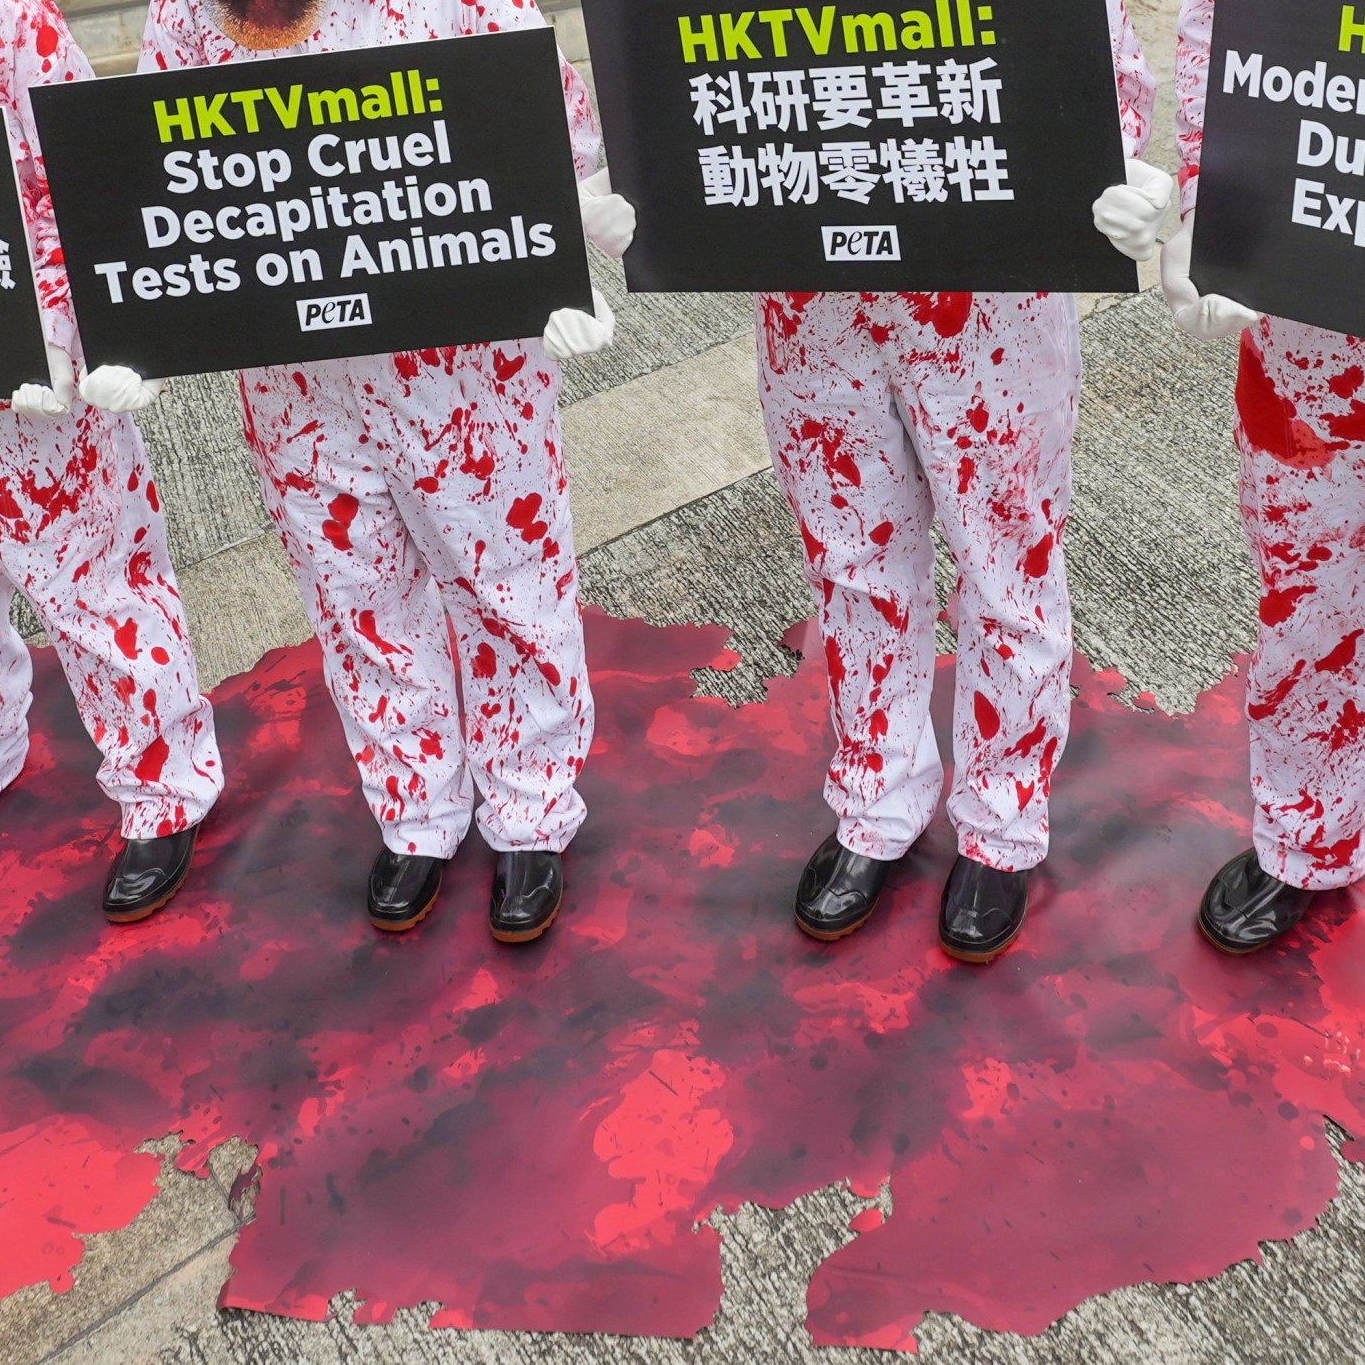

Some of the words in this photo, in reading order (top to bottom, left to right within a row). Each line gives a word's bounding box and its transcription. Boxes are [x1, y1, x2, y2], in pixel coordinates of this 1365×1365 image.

[154, 70, 443, 143] HKTVmall:
[689, 57, 1002, 135] 科研要革新
[163, 148, 291, 193] Stop
[308, 120, 451, 177] Cruel
[698, 136, 1014, 207] 動物零犧牲
[141, 176, 492, 248] Decapitation
[94, 253, 239, 303] Tests
[256, 249, 323, 286] on
[341, 216, 556, 278] Animals
